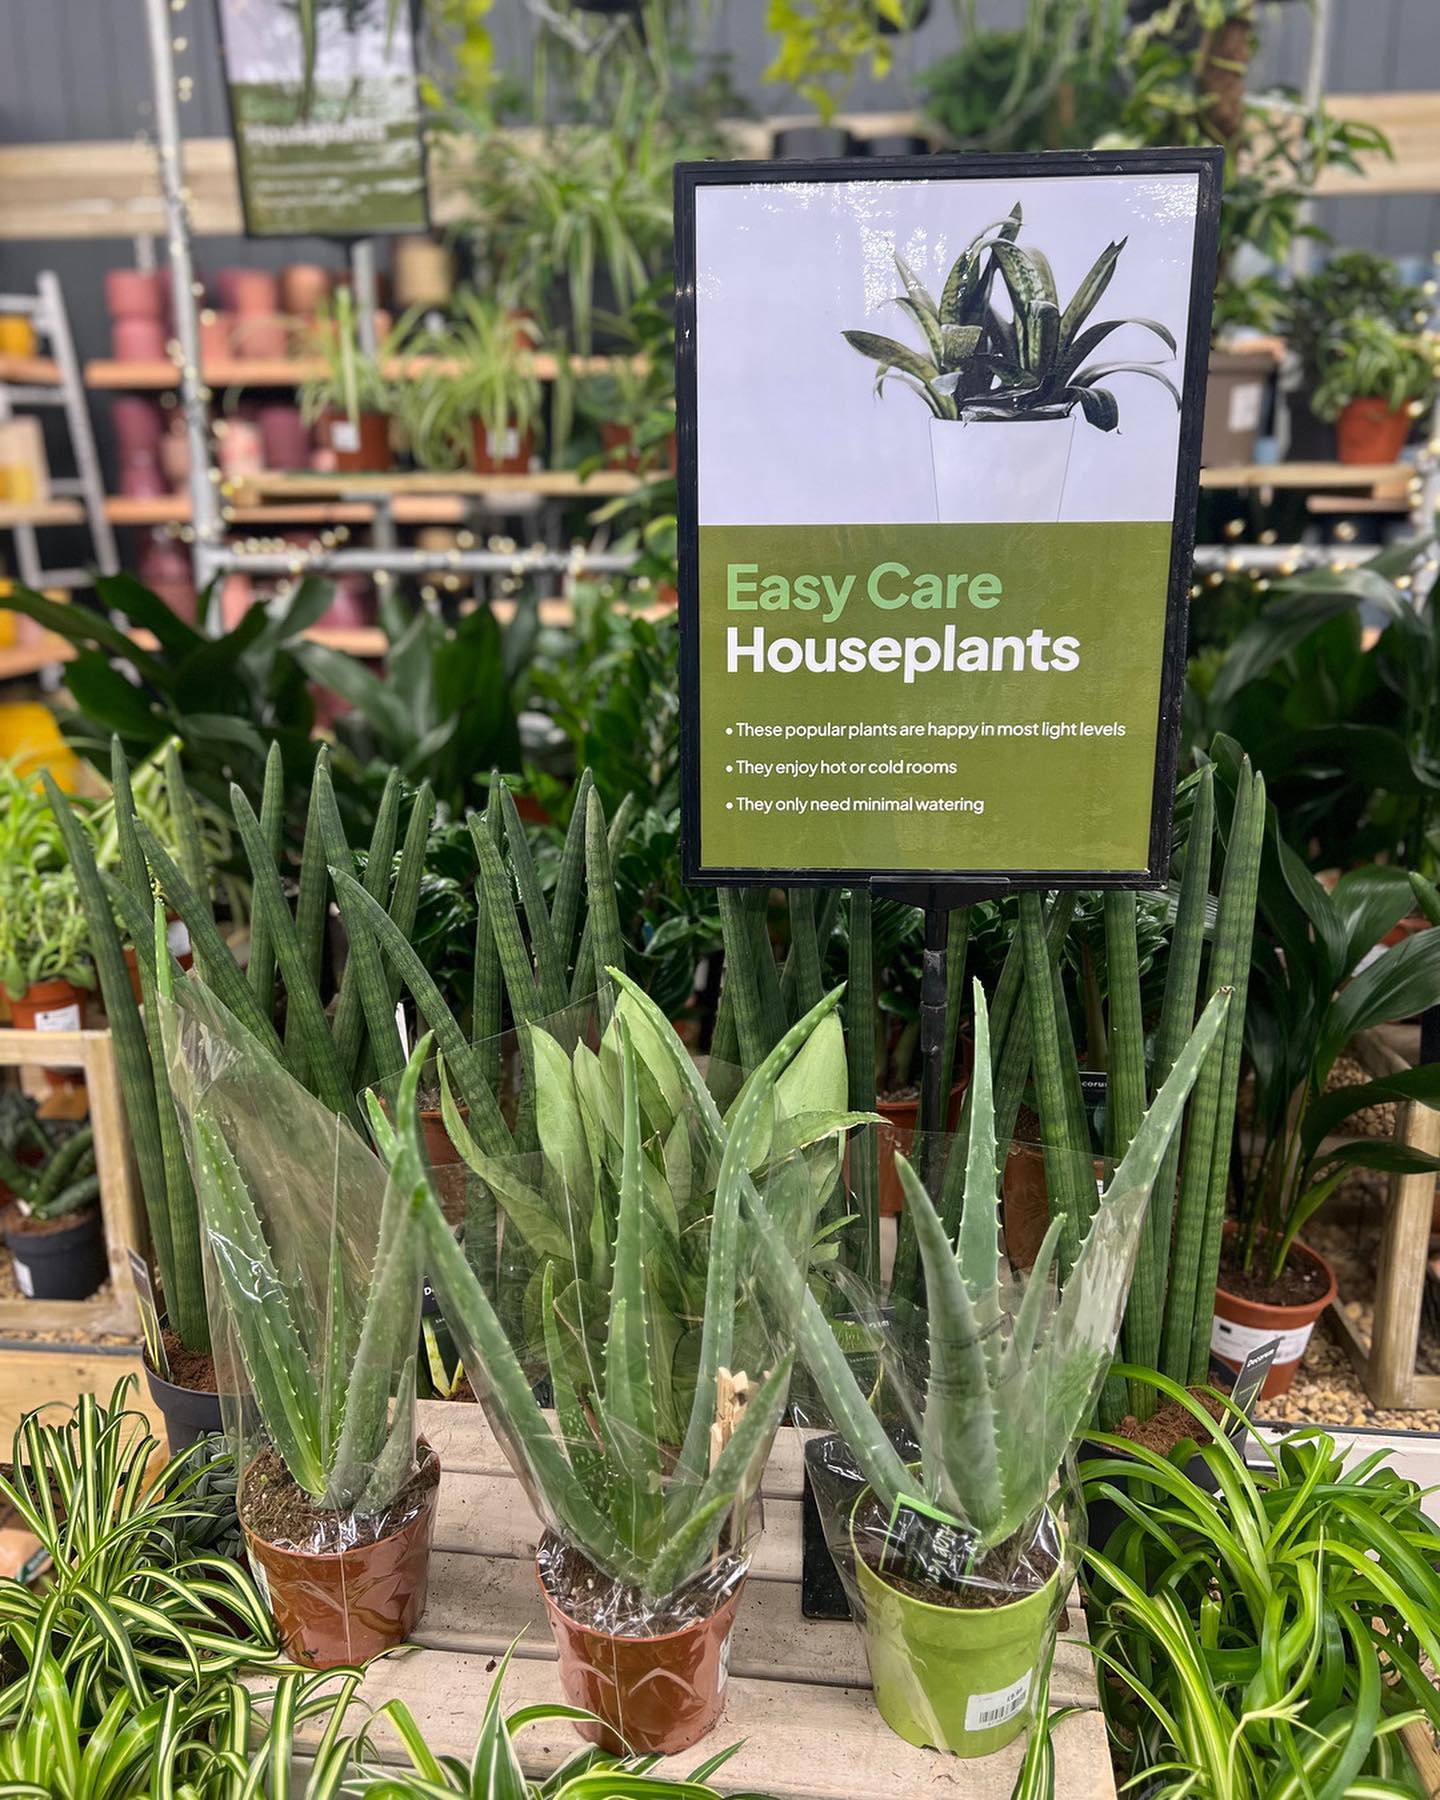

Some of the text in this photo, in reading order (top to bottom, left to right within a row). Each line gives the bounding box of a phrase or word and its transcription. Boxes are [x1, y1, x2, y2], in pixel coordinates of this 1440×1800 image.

[727, 561, 1003, 623] Easy Care
[727, 624, 1081, 684] Houseplants
[736, 721, 1126, 740] These popular plants are happy in most light levels
[736, 759, 958, 778] They enjoy hot or cold rooms
[736, 797, 985, 815] They only need minimal watering
